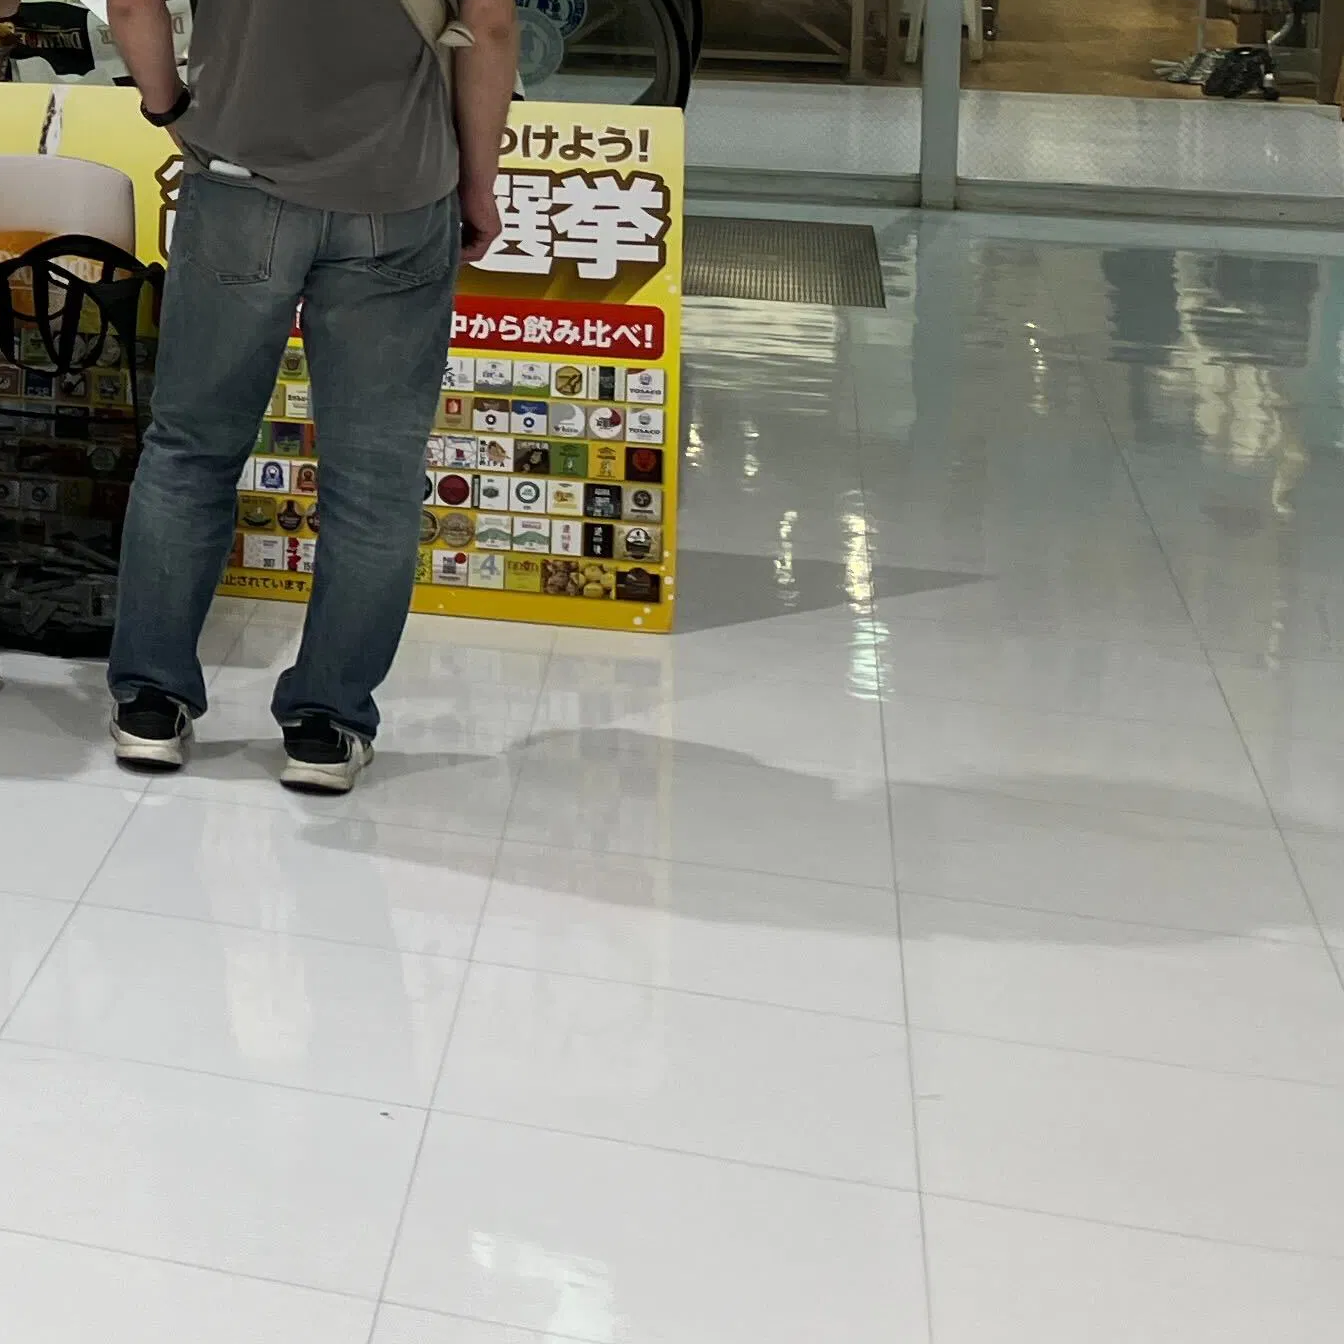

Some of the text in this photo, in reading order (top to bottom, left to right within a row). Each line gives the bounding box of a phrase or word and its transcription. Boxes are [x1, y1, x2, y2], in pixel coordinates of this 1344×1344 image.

[219, 573, 311, 593] 止されています。
